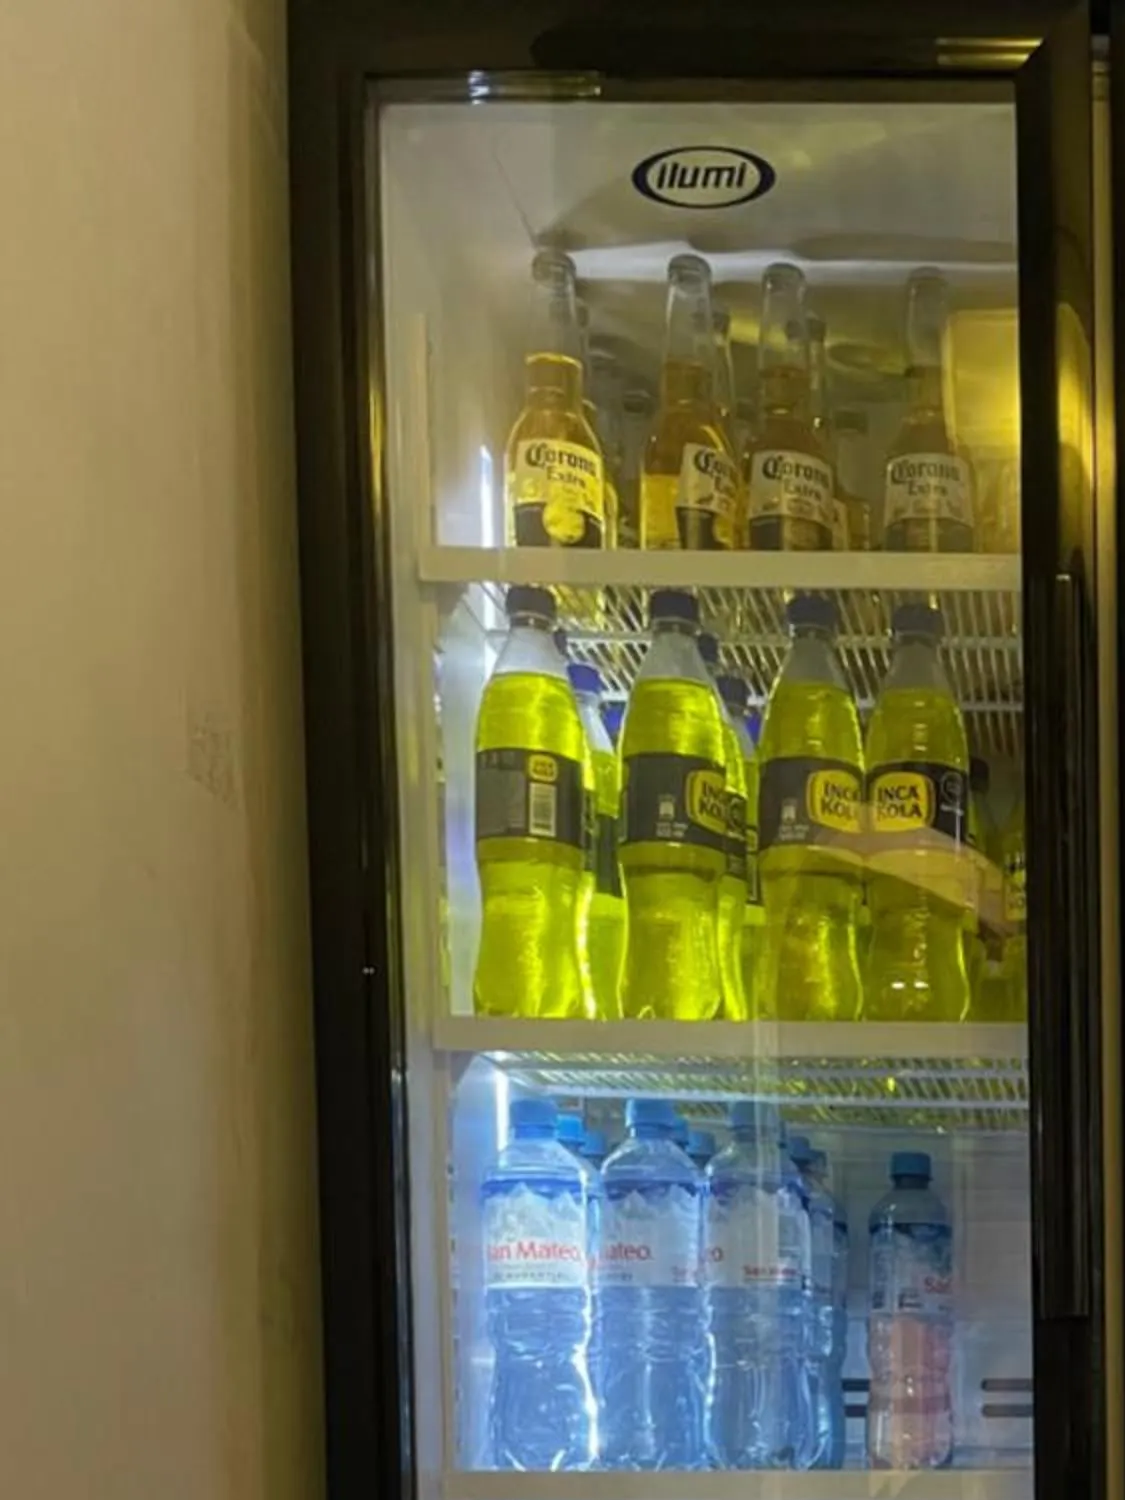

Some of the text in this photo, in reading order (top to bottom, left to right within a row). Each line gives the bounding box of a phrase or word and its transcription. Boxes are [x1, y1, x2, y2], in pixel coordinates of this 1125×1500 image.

[762, 455, 830, 489] Corona
[889, 459, 961, 485] Corona
[877, 784, 919, 801] INCA
[821, 800, 857, 821] KOL
[876, 803, 923, 821] KOLA
[517, 1240, 579, 1262] Mateo
[605, 1243, 652, 1261] ateo
